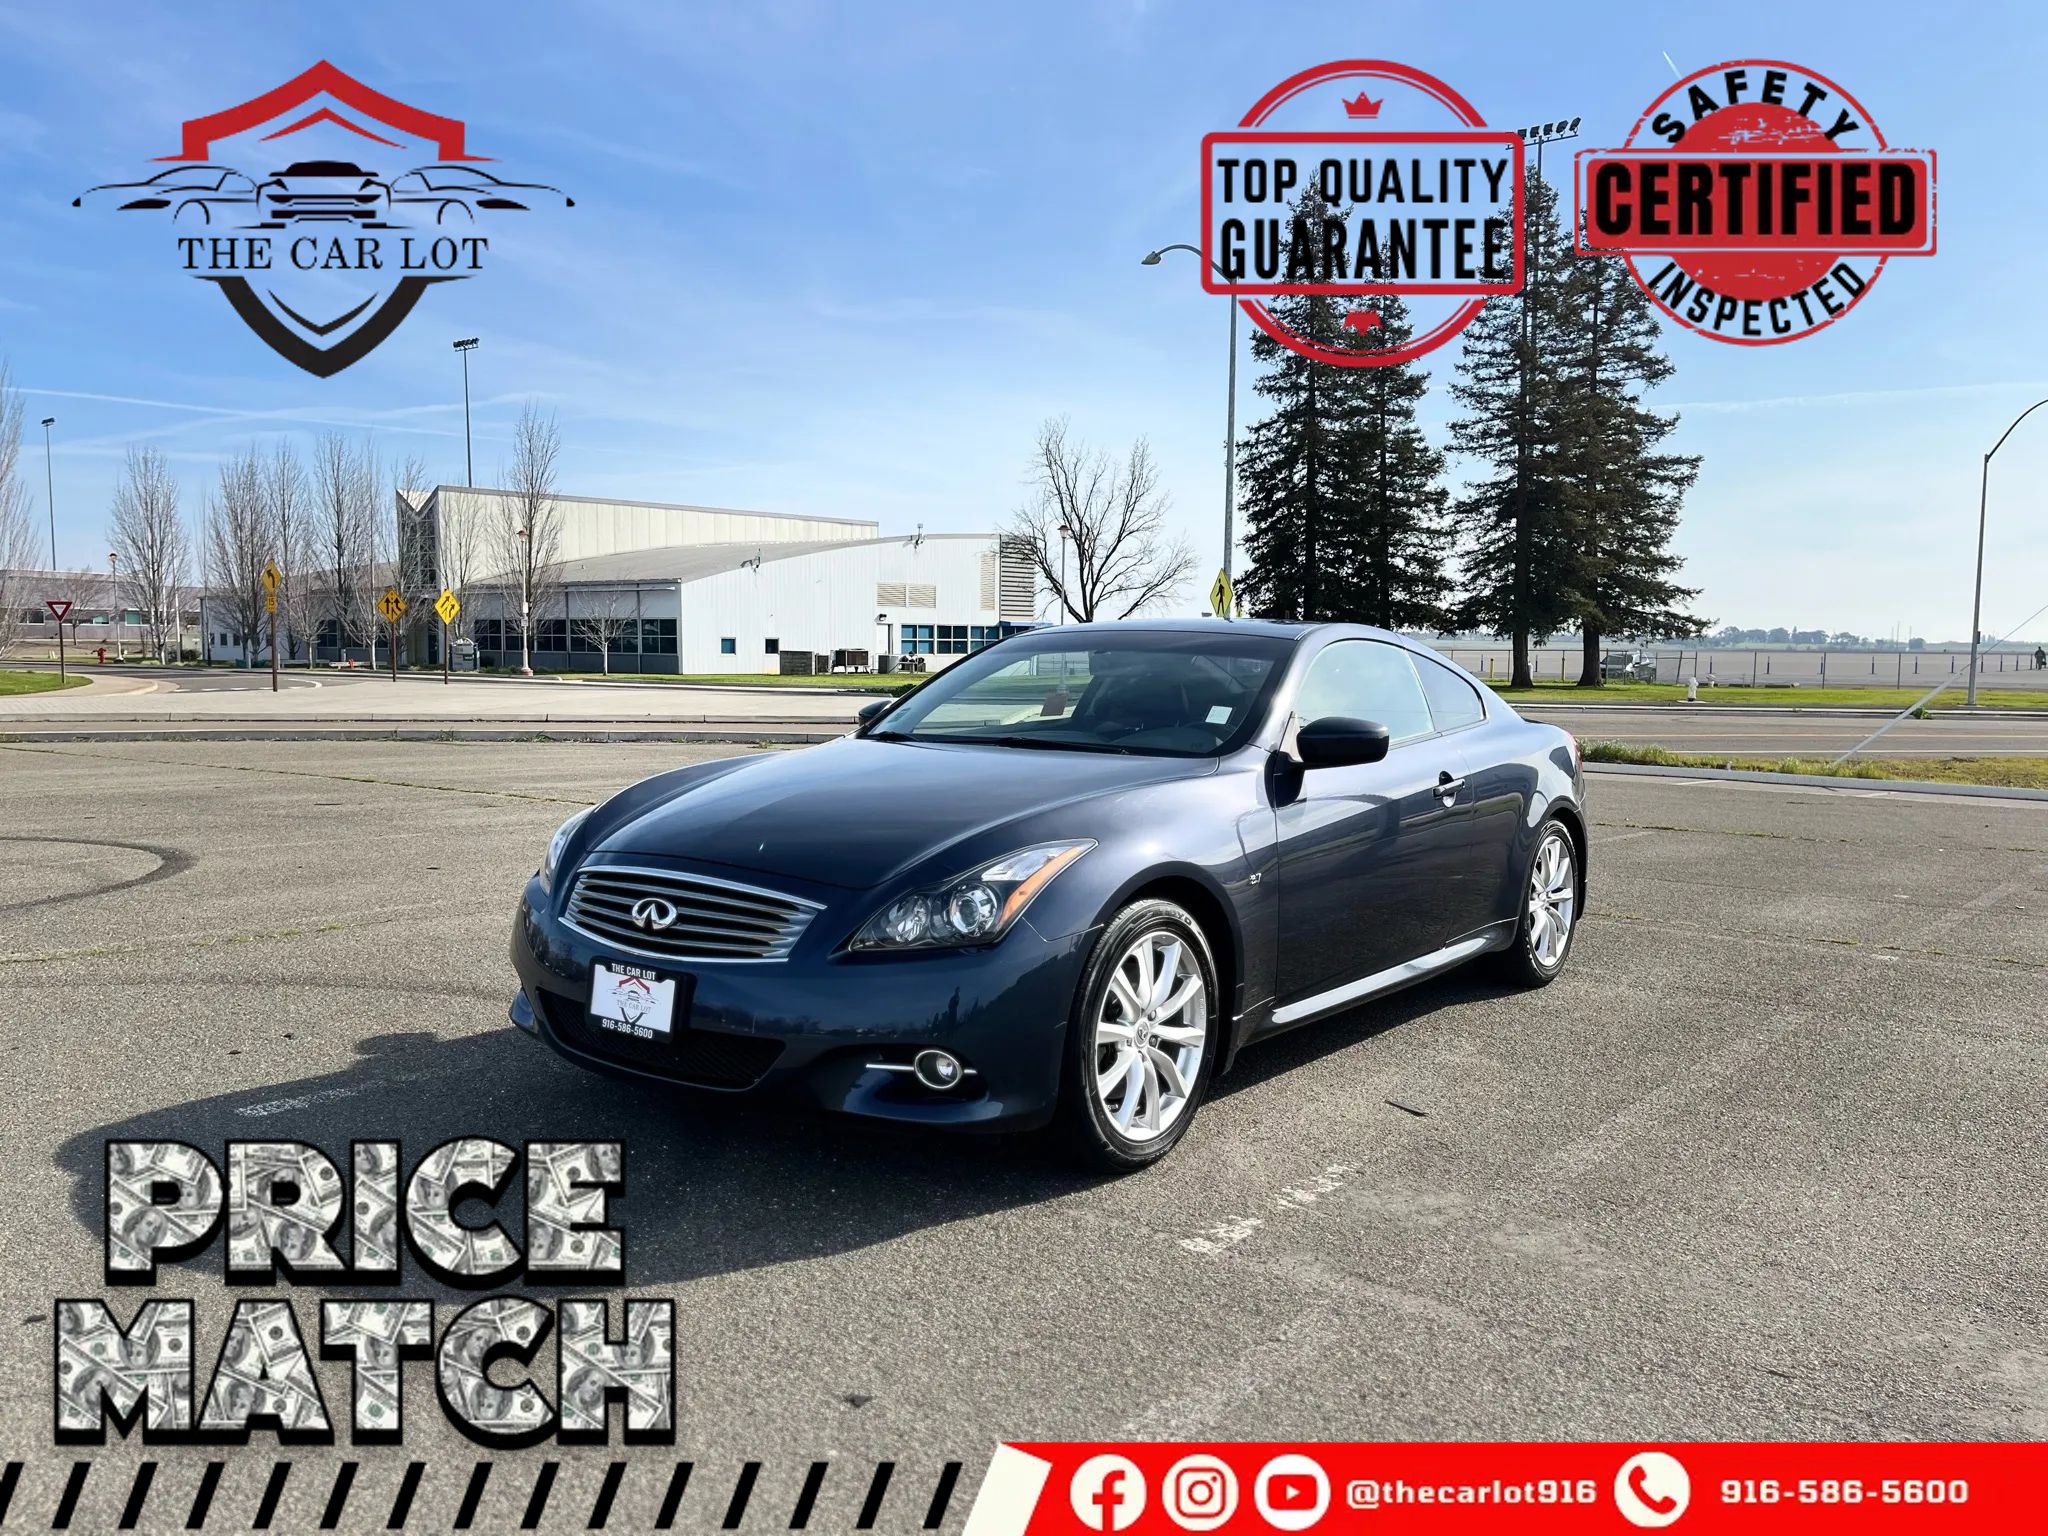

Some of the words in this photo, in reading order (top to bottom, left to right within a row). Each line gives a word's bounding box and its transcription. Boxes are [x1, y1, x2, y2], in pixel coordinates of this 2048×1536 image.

[611, 963, 625, 974] THE
[626, 966, 641, 977] CAR
[642, 970, 656, 980] LOT
[602, 1018, 653, 1039] 916-586-5600
